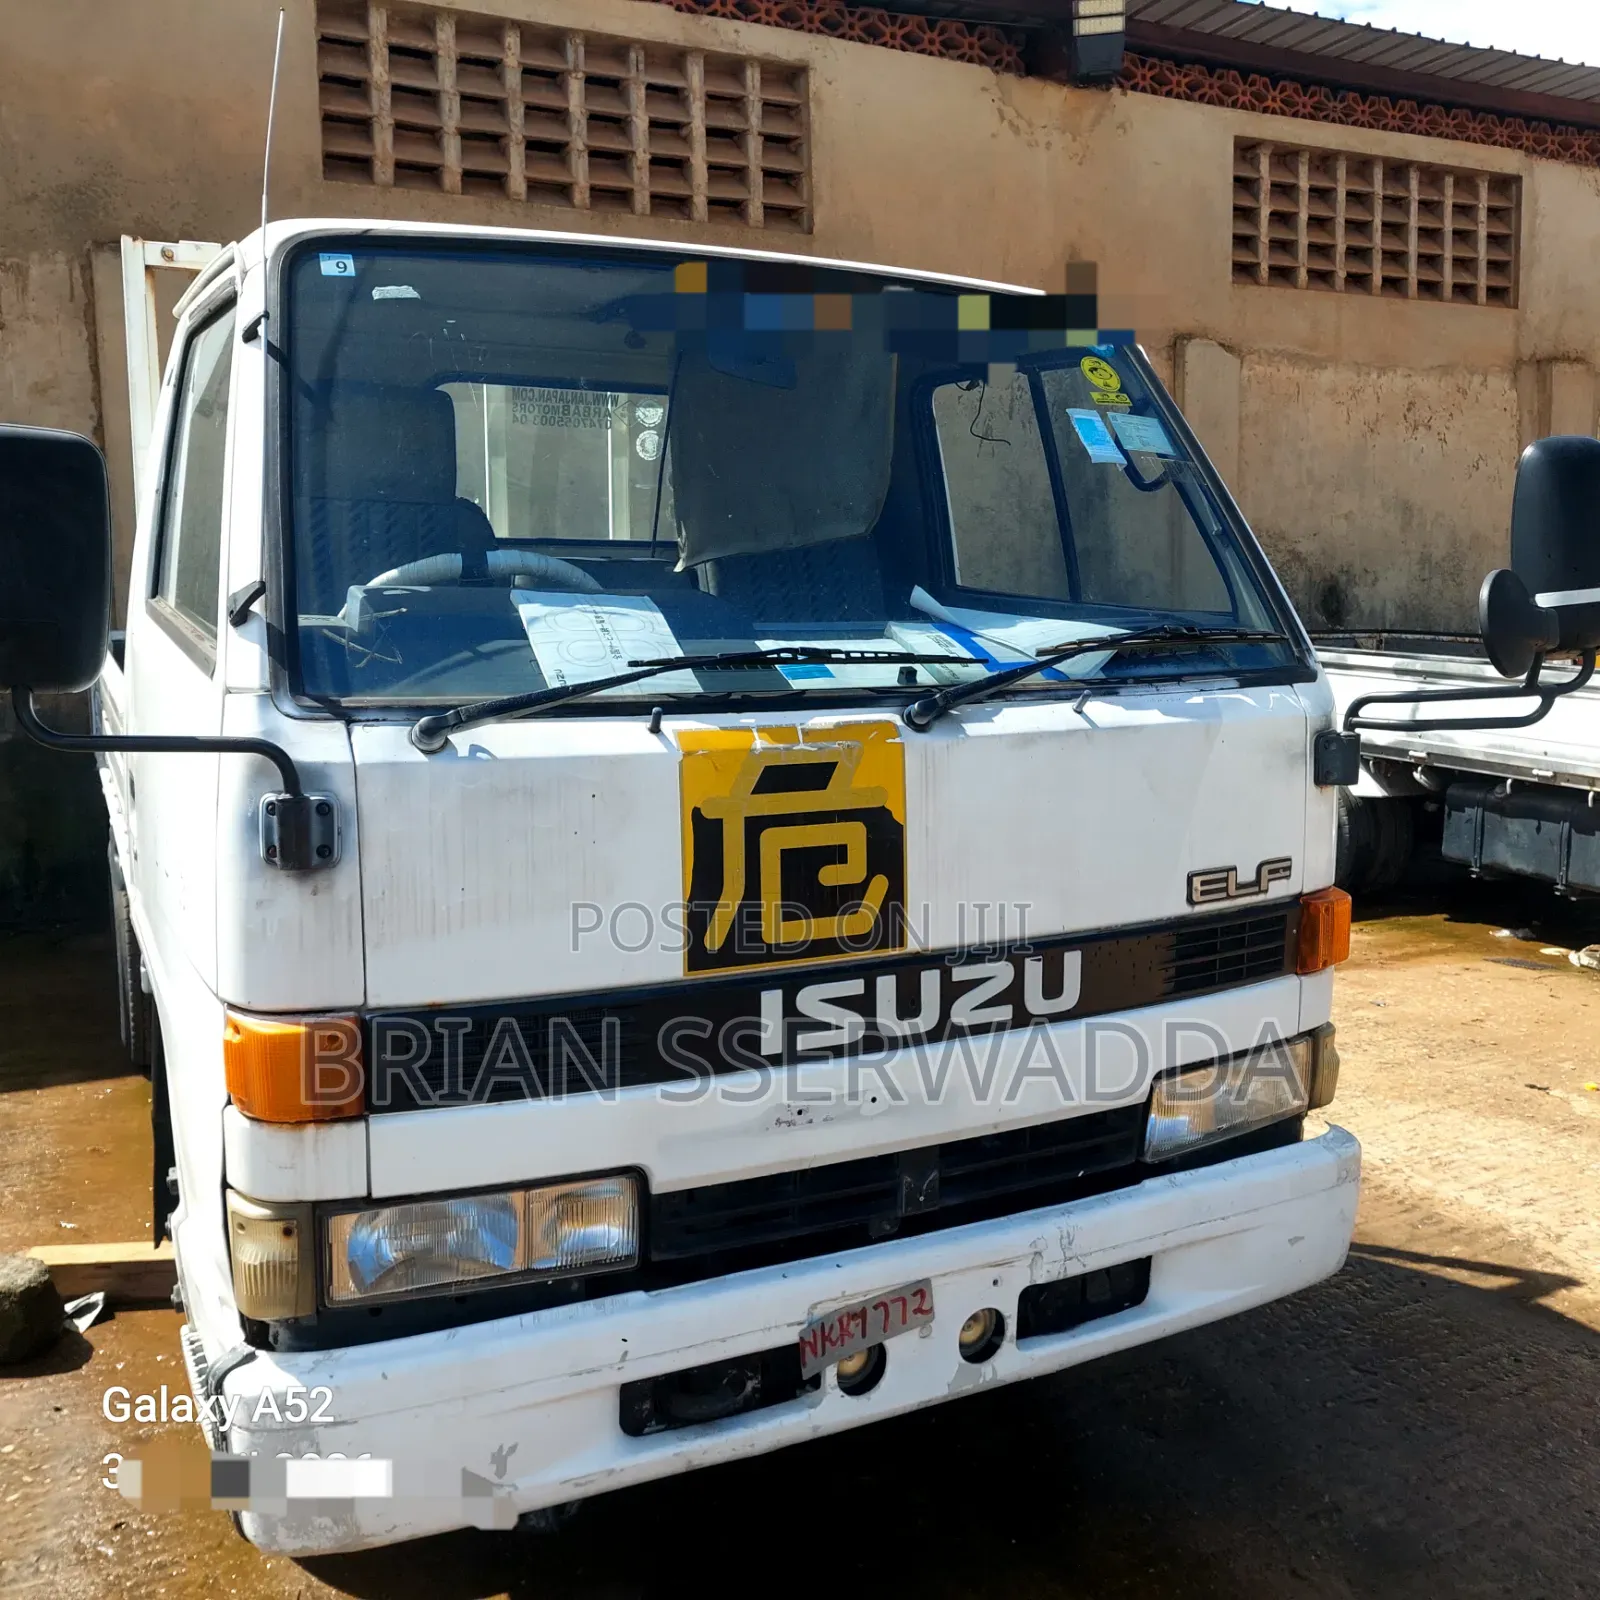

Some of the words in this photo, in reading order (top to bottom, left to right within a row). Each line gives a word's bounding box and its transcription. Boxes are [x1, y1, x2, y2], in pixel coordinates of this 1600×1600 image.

[335, 260, 348, 274] 9
[1186, 856, 1292, 906] ELF
[760, 950, 1082, 1056] ISUZU
